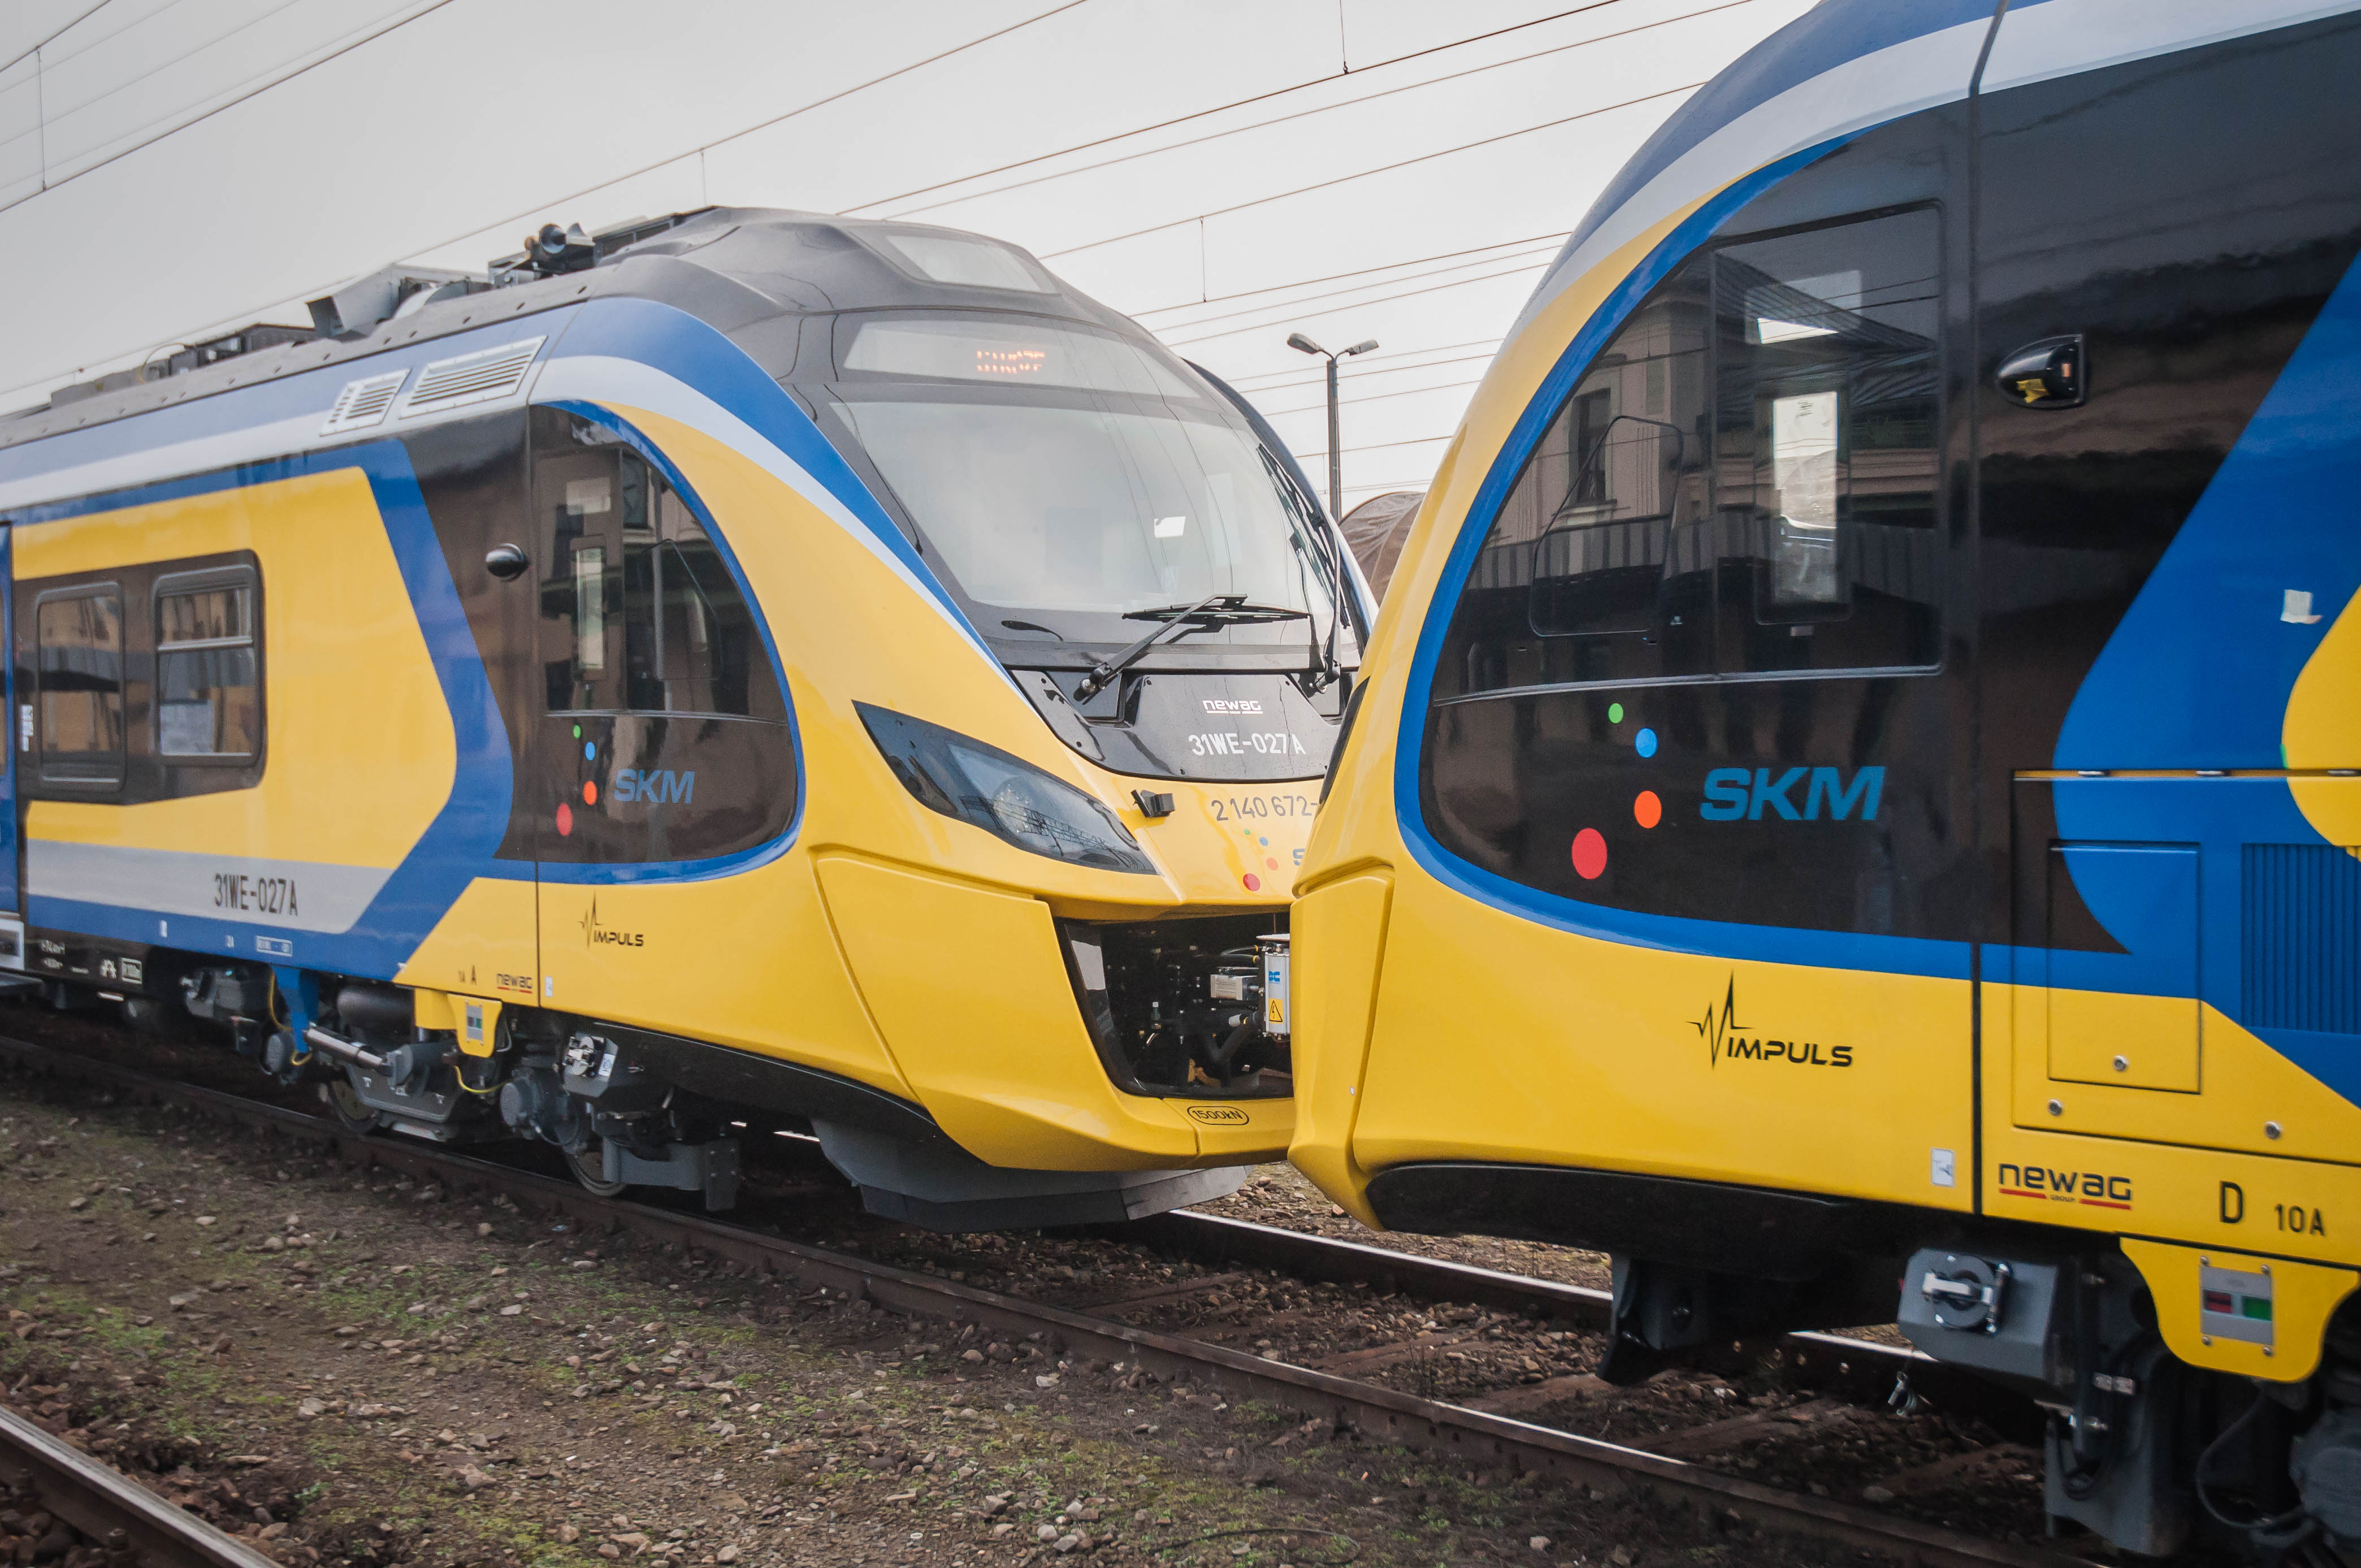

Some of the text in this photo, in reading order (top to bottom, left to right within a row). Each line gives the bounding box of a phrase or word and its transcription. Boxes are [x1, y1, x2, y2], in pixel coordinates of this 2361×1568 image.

[1188, 733, 1306, 756] 31WE-027A
[614, 769, 695, 804] SKM
[1700, 765, 1886, 820] SKM
[215, 873, 298, 917] 31WE-027A
[594, 930, 644, 947] IMPULS
[1727, 1037, 1853, 1067] IMPULS
[1192, 1110, 1244, 1119] 1500kN
[2219, 1180, 2325, 1236] D 10A
